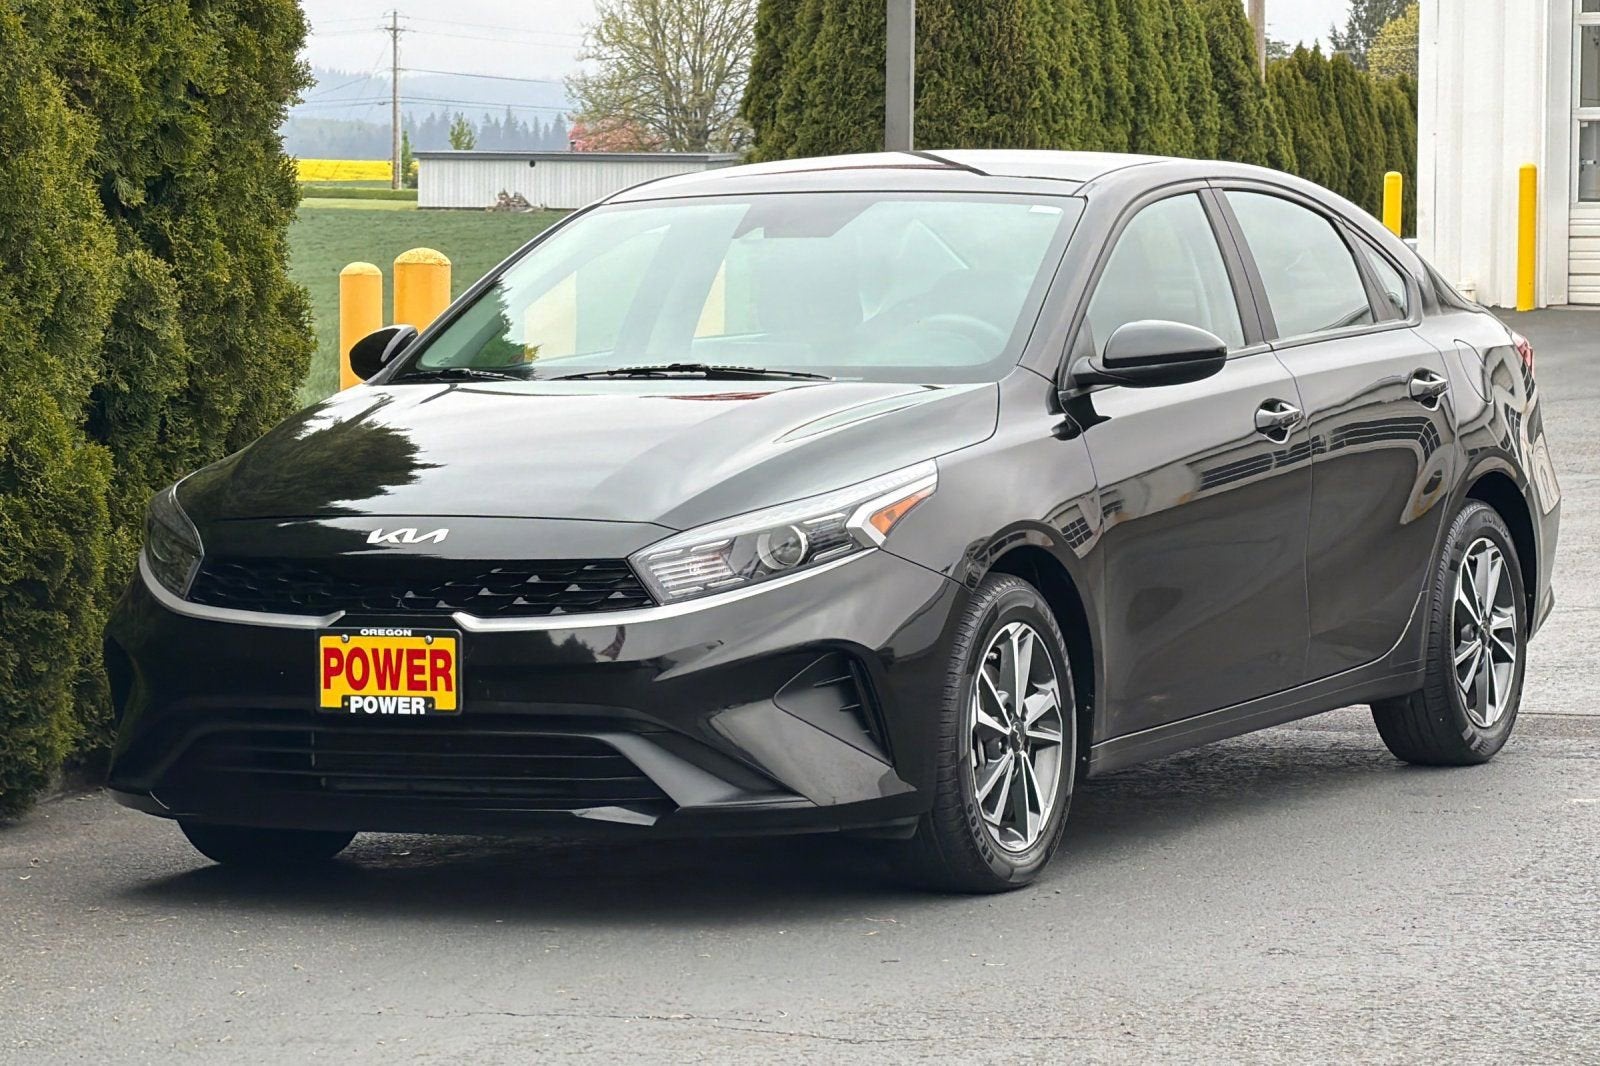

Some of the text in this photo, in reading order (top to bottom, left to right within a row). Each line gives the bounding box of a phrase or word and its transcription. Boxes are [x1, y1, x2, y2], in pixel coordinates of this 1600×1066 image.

[366, 528, 449, 544] KIA
[360, 628, 412, 637] OREGON
[323, 647, 453, 692] POWER
[350, 696, 426, 715] POWER
